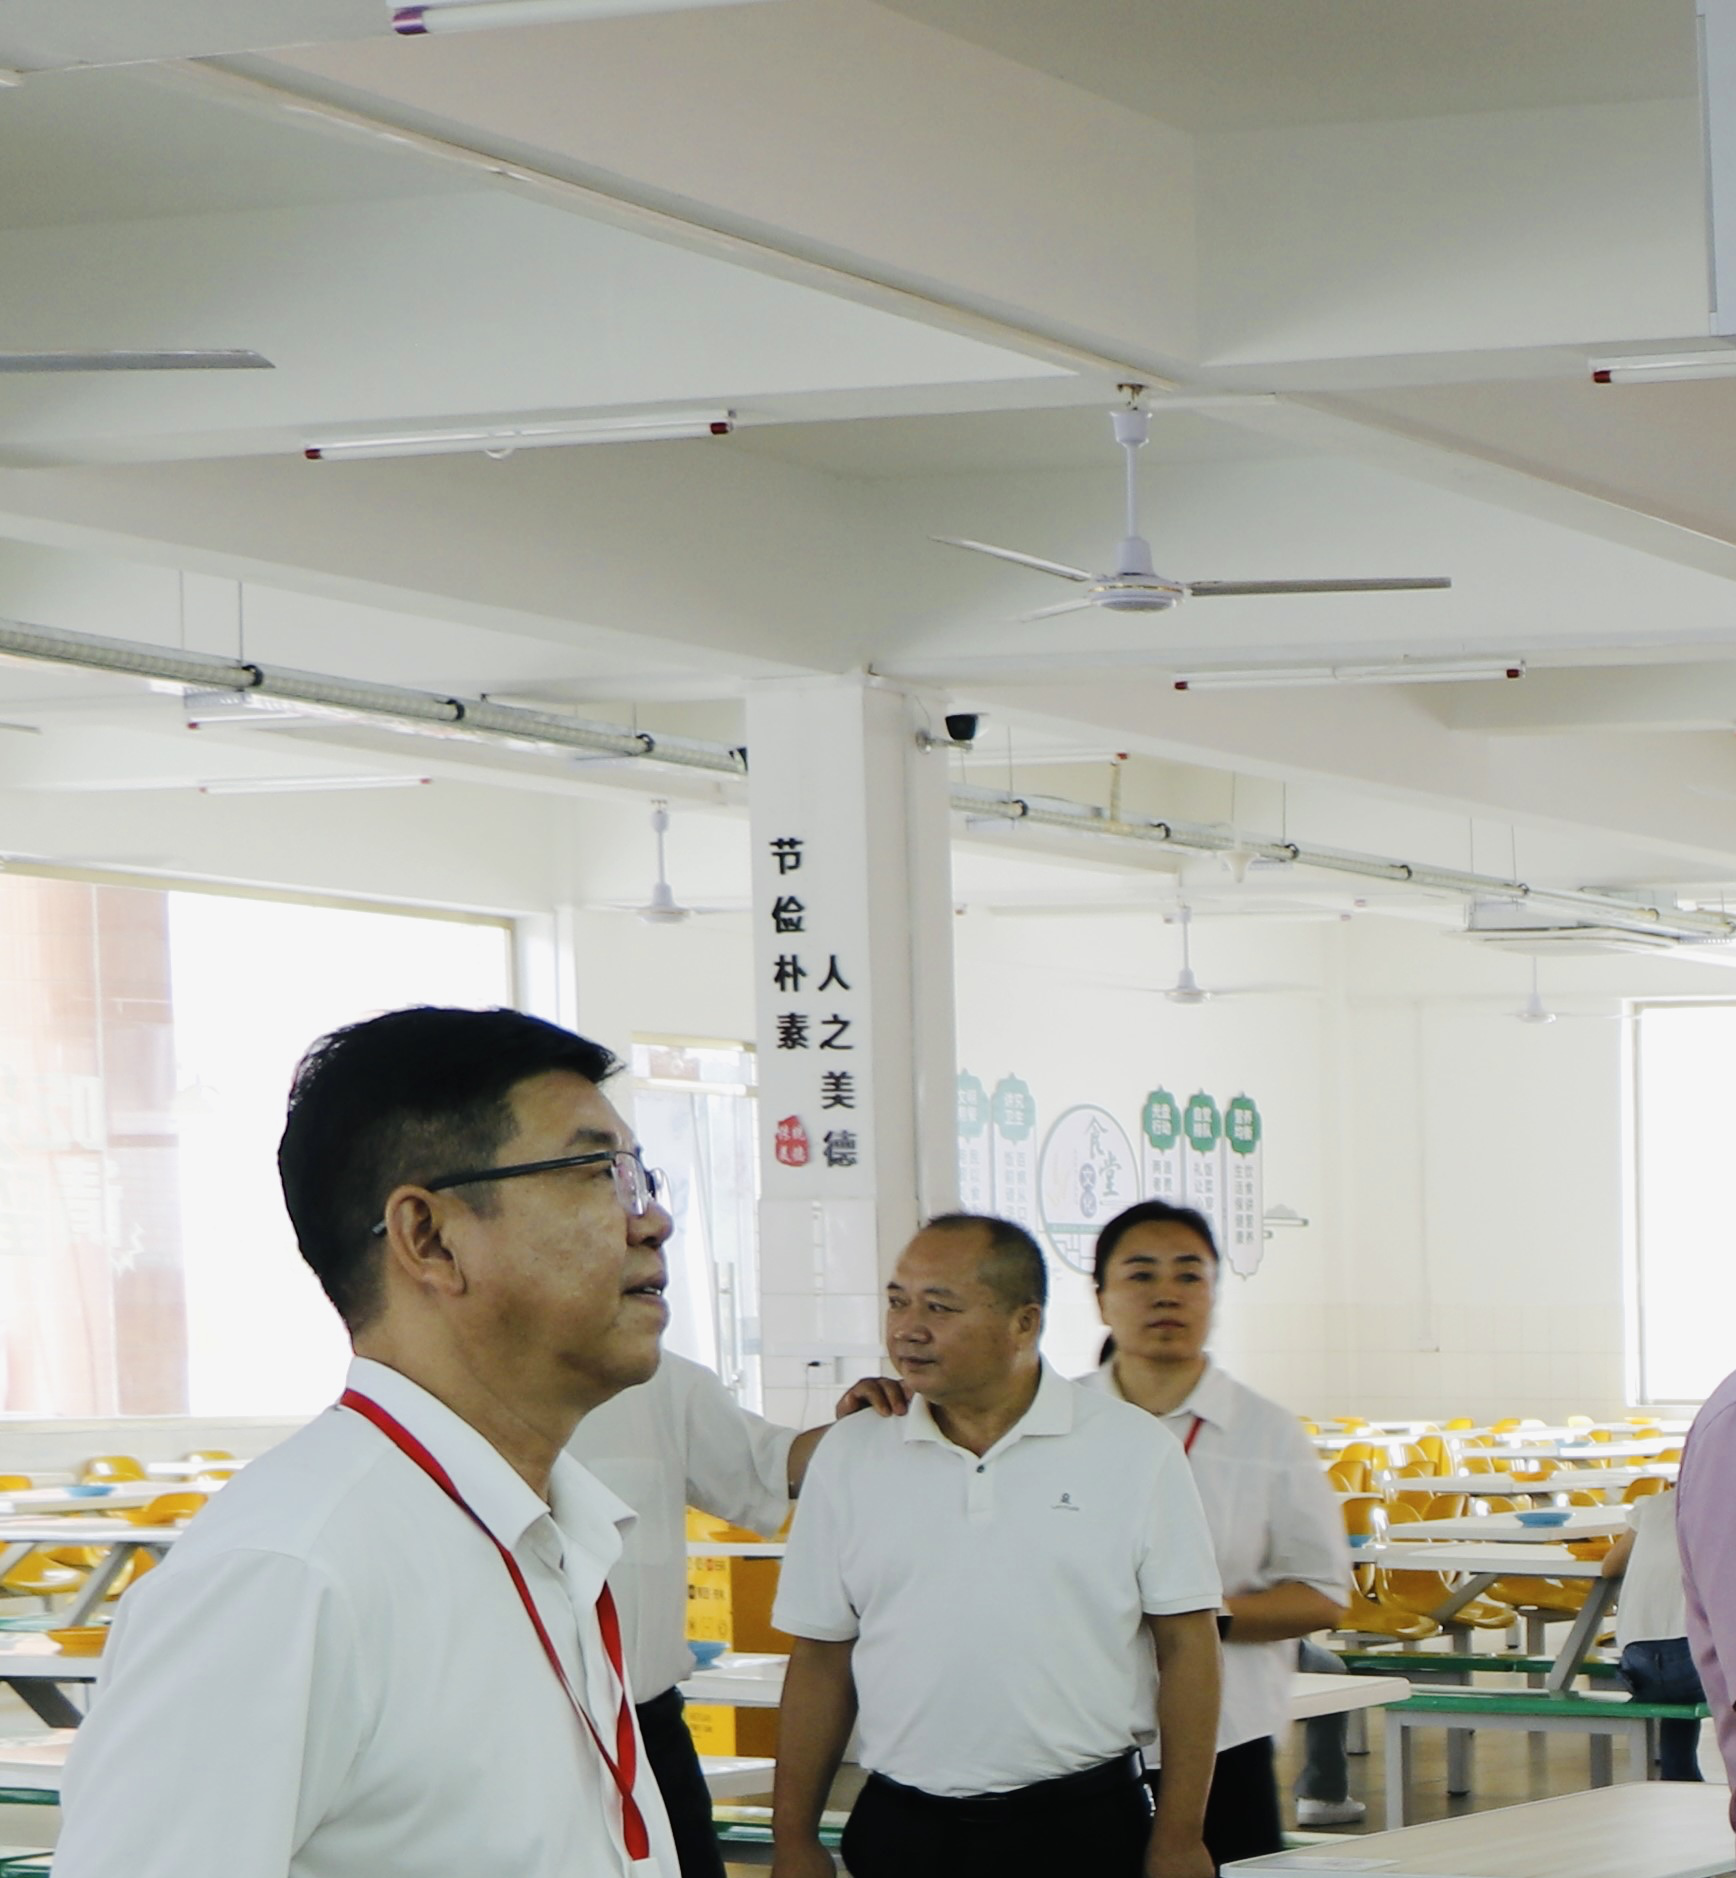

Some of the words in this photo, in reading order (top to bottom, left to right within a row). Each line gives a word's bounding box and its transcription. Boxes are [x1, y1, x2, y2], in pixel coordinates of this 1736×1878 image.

[769, 837, 810, 1051] 节俭朴素
[817, 954, 858, 1168] 人之美德
